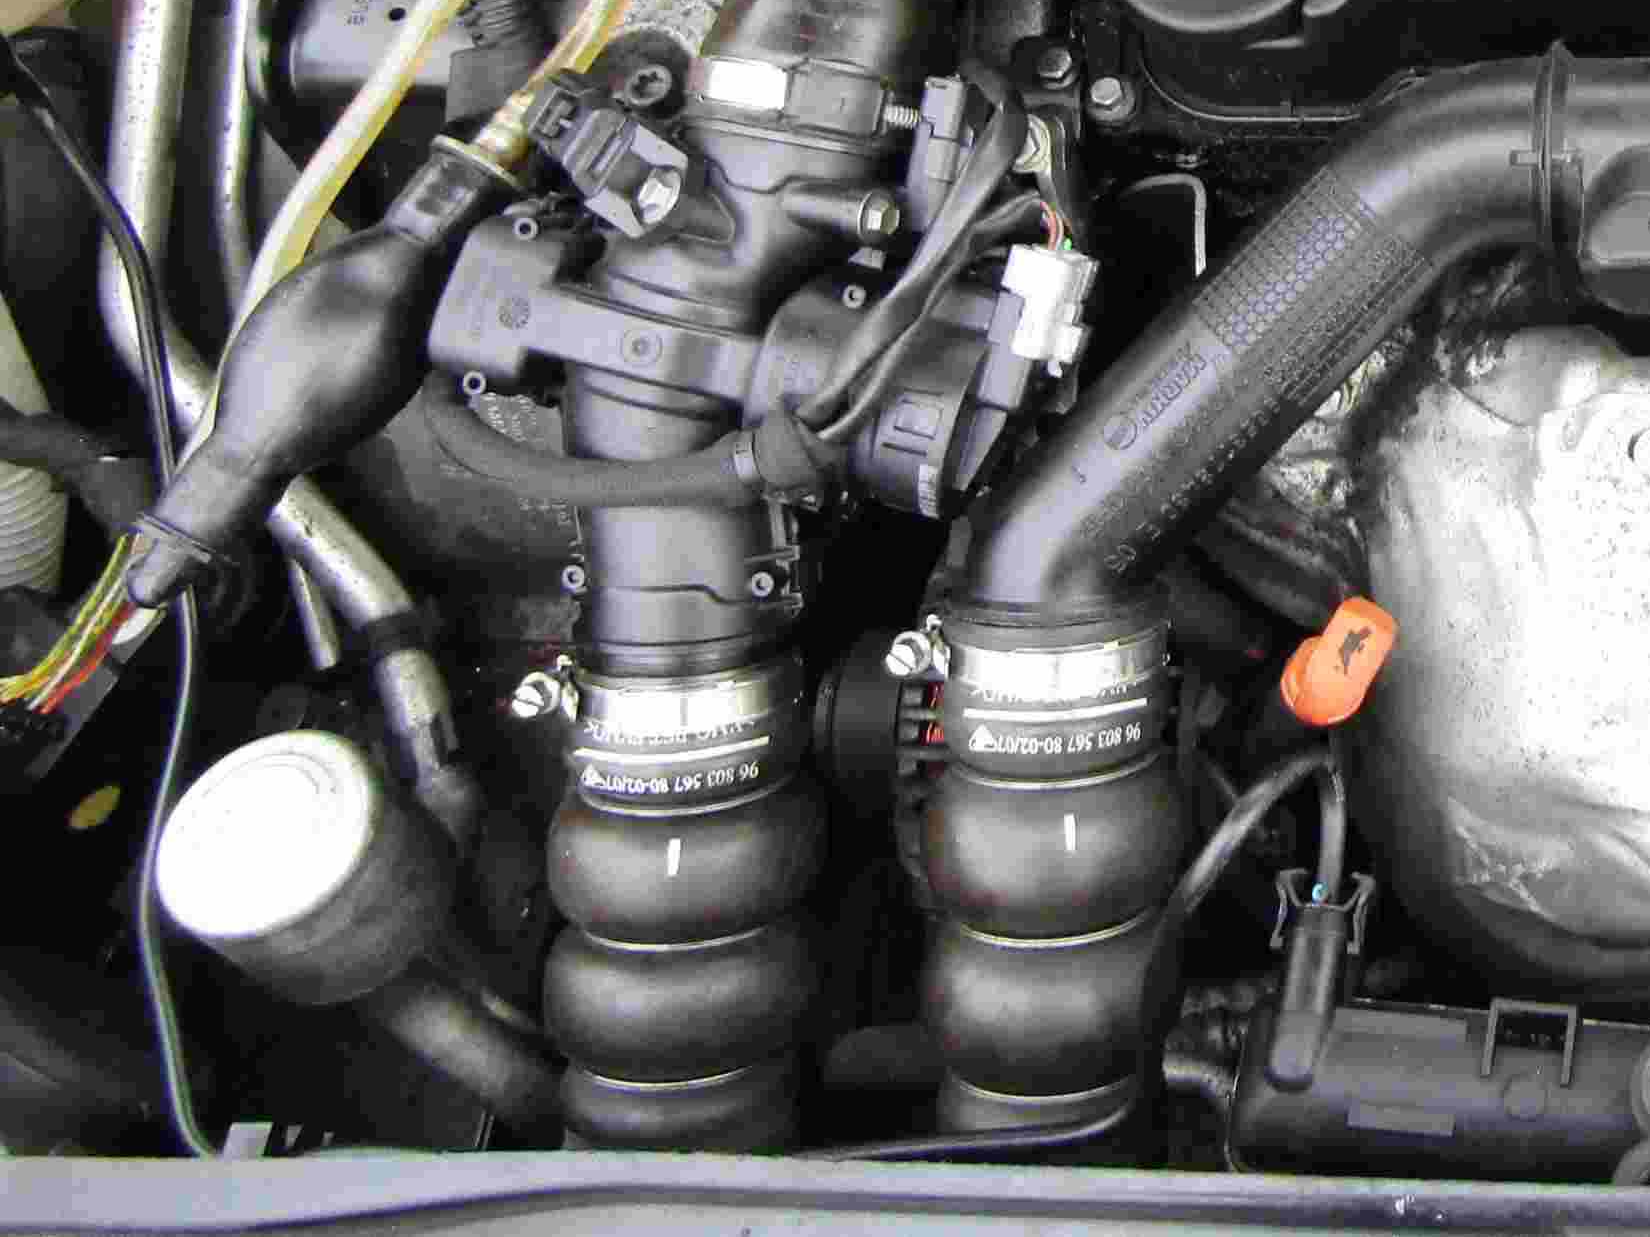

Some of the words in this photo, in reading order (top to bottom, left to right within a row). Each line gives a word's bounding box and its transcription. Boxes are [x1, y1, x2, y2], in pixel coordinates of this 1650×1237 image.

[1098, 726, 1122, 749] 803
[1125, 721, 1142, 741] 96
[1067, 732, 1093, 753] 567
[707, 767, 735, 787] 803
[739, 761, 759, 780] 96
[674, 773, 702, 793] 567
